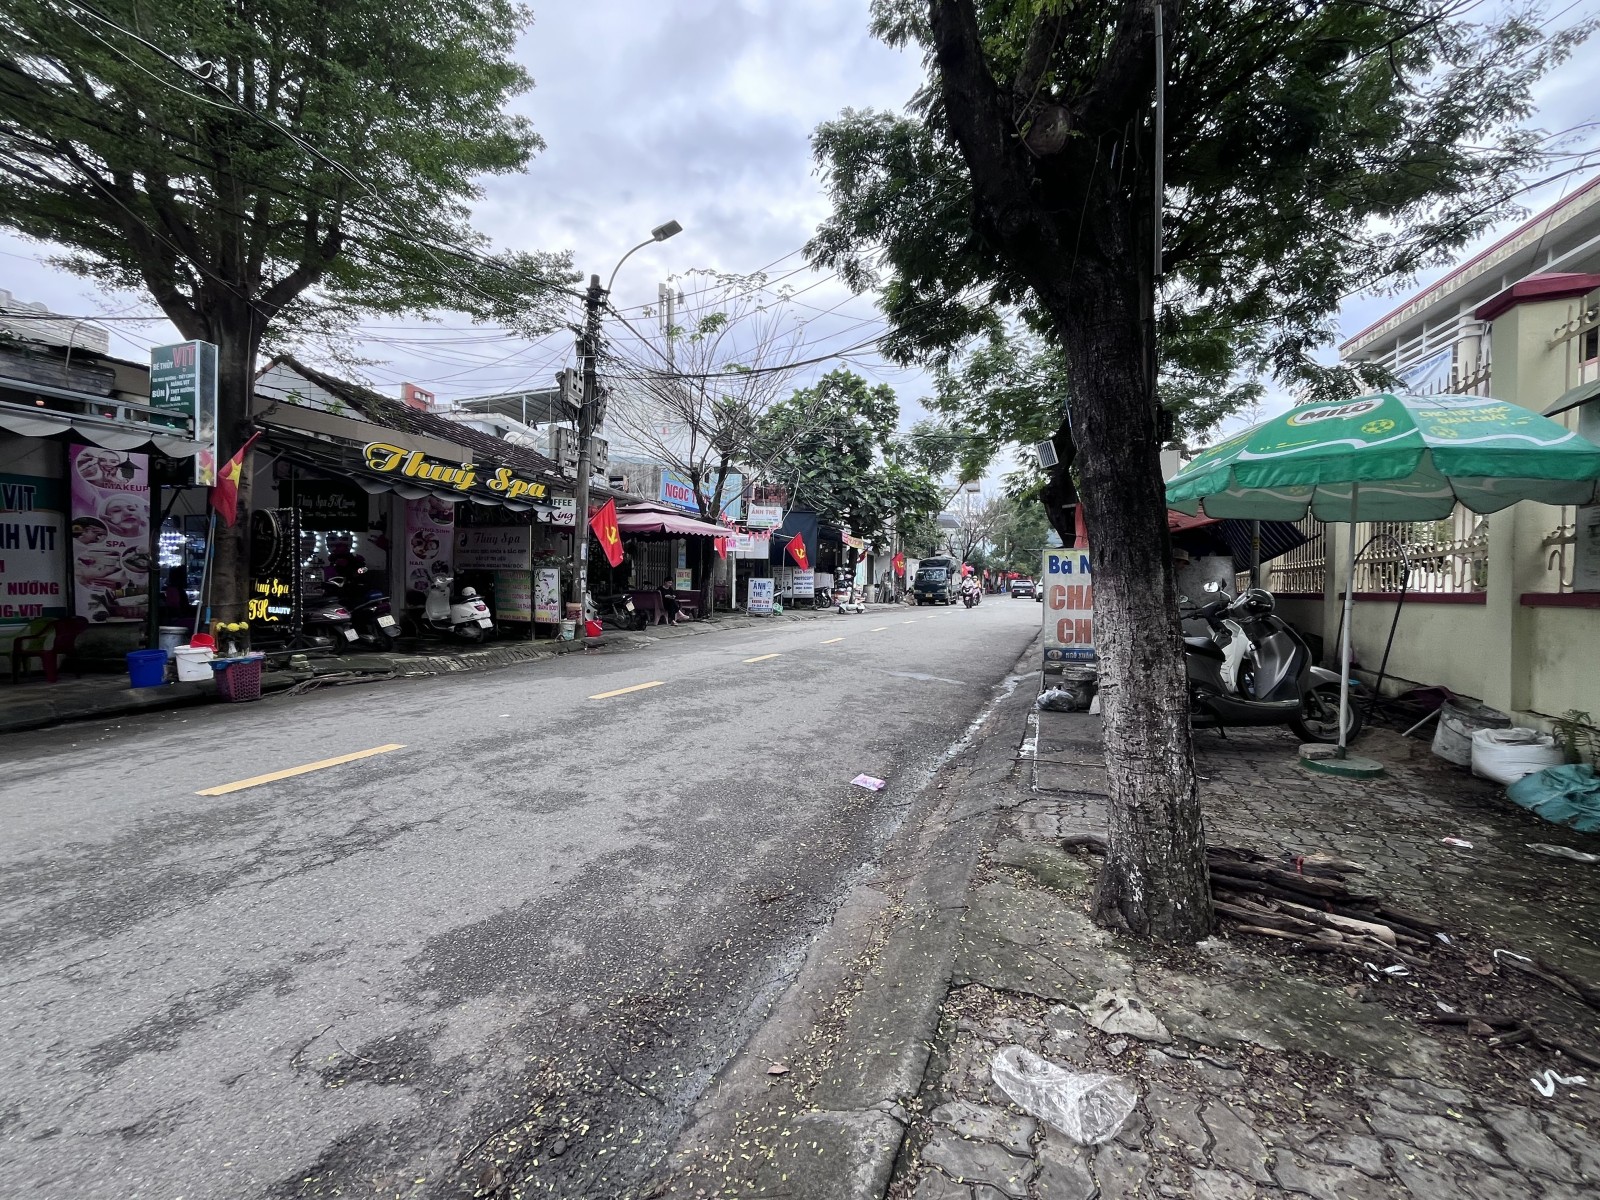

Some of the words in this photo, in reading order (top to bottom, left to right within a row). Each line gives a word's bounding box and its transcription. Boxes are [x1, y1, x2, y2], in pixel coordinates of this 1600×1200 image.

[173, 345, 196, 373] VỊT
[152, 389, 165, 398] BÚN
[1299, 403, 1374, 421] MILO
[104, 482, 149, 492] MAKEUP
[486, 467, 546, 499] Spa
[0, 482, 37, 514] VỊT
[25, 524, 57, 554] VỊT
[106, 540, 126, 548] SPA
[501, 532, 521, 546] Spa
[1048, 555, 1073, 575] Bà
[271, 578, 289, 597] Spa
[752, 580, 766, 590] ẢNH
[18, 603, 43, 620] VỊT
[267, 606, 291, 615] BEAUTY
[1057, 618, 1092, 644] CH
